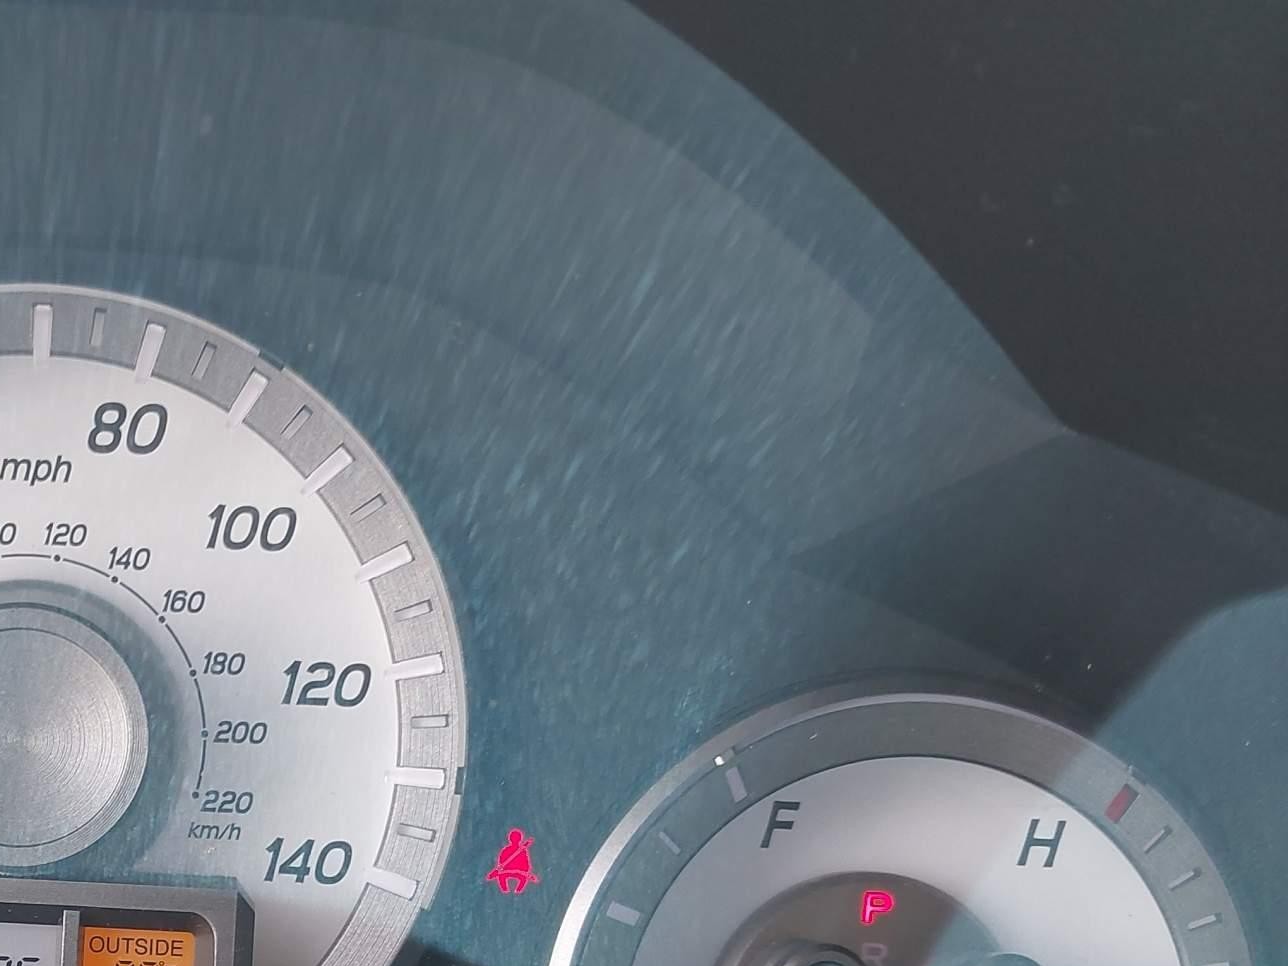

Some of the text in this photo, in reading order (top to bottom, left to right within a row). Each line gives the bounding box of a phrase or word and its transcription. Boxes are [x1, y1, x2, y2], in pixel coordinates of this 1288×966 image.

[87, 402, 168, 455] 80
[0, 455, 72, 486] mph
[44, 523, 87, 547] 120
[206, 504, 297, 551] 100
[108, 546, 151, 571] 140
[162, 590, 205, 613] 160
[202, 652, 246, 676] 180
[280, 661, 372, 707] 120
[213, 721, 268, 745] 200
[200, 790, 254, 815] 220
[187, 821, 242, 841] km/h
[761, 801, 800, 849] F
[1016, 818, 1066, 868] H
[264, 837, 353, 885] 140
[860, 889, 896, 925] P
[89, 935, 185, 958] OUTSIDE
